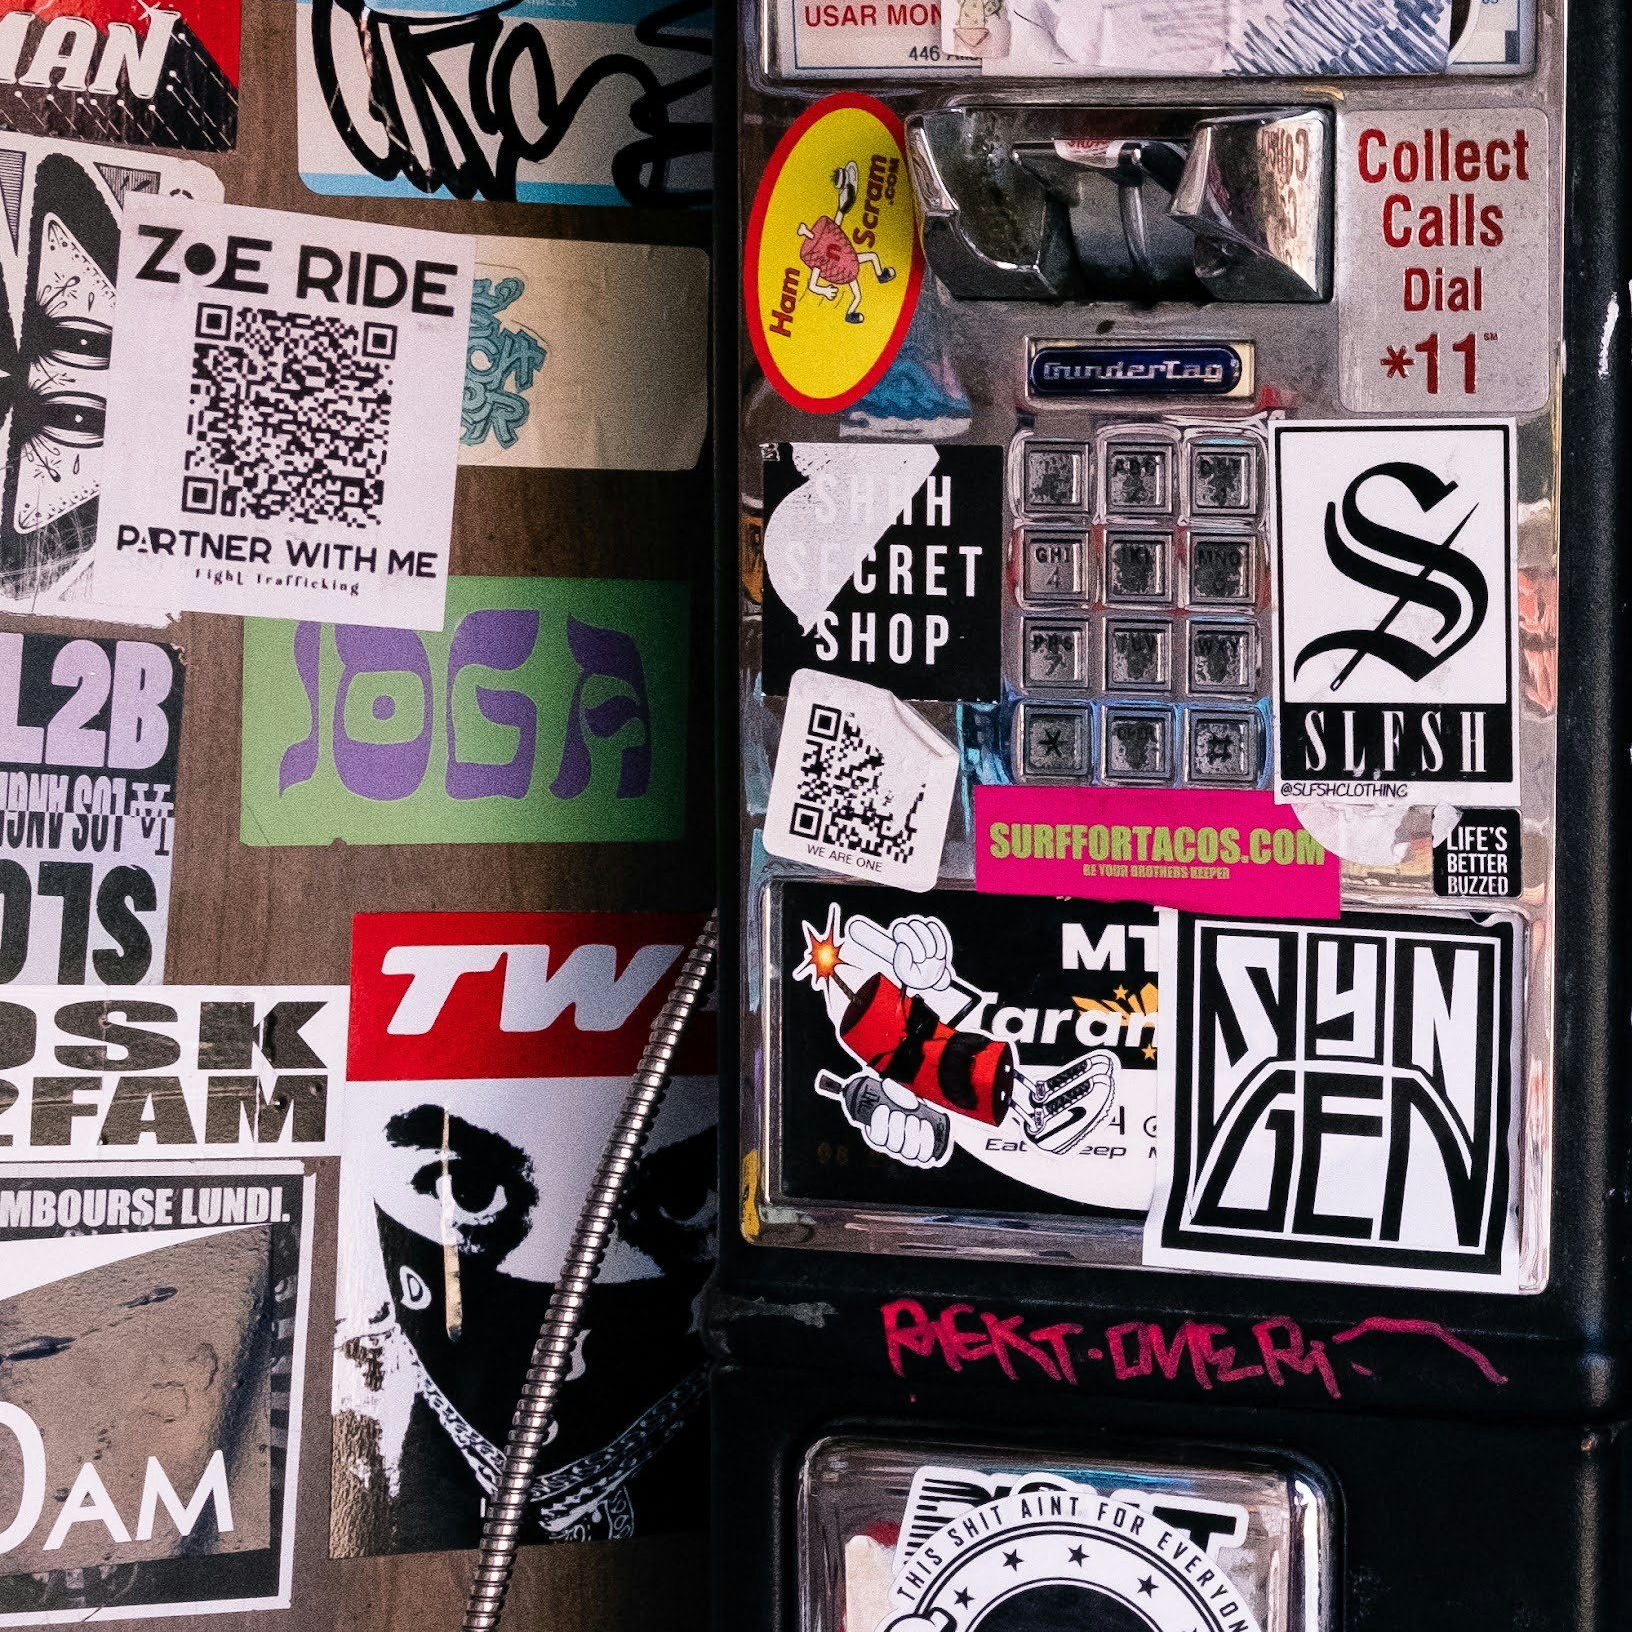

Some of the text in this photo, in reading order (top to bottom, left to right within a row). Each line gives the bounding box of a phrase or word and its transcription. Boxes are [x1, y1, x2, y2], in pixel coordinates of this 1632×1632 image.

[804, 2, 866, 29] USAR
[1358, 128, 1531, 186] Collect
[1382, 193, 1504, 250] Calls
[769, 153, 888, 339] Ham Scram
[296, 243, 458, 318] RIDE
[1402, 265, 1484, 313] Dial
[117, 524, 438, 579] PARTNER WITH ME
[1034, 546, 1072, 564] GHI
[815, 611, 951, 664] SHOP
[829, 850, 882, 873] ARE ONE
[990, 821, 1326, 867] SURFFORTACOS.COM
[1446, 827, 1509, 854] LIFE'S
[1446, 852, 1509, 874] BETTER
[1098, 864, 1230, 881] YOUR BROTHERS KEEPER
[1446, 874, 1509, 897] BUZZED
[181, 1185, 292, 1225] LUNDI.
[897, 1546, 943, 1602] THIS
[948, 1502, 1005, 1546] SHIT
[1020, 1495, 1081, 1521] AINT
[1096, 1500, 1145, 1535] FOR
